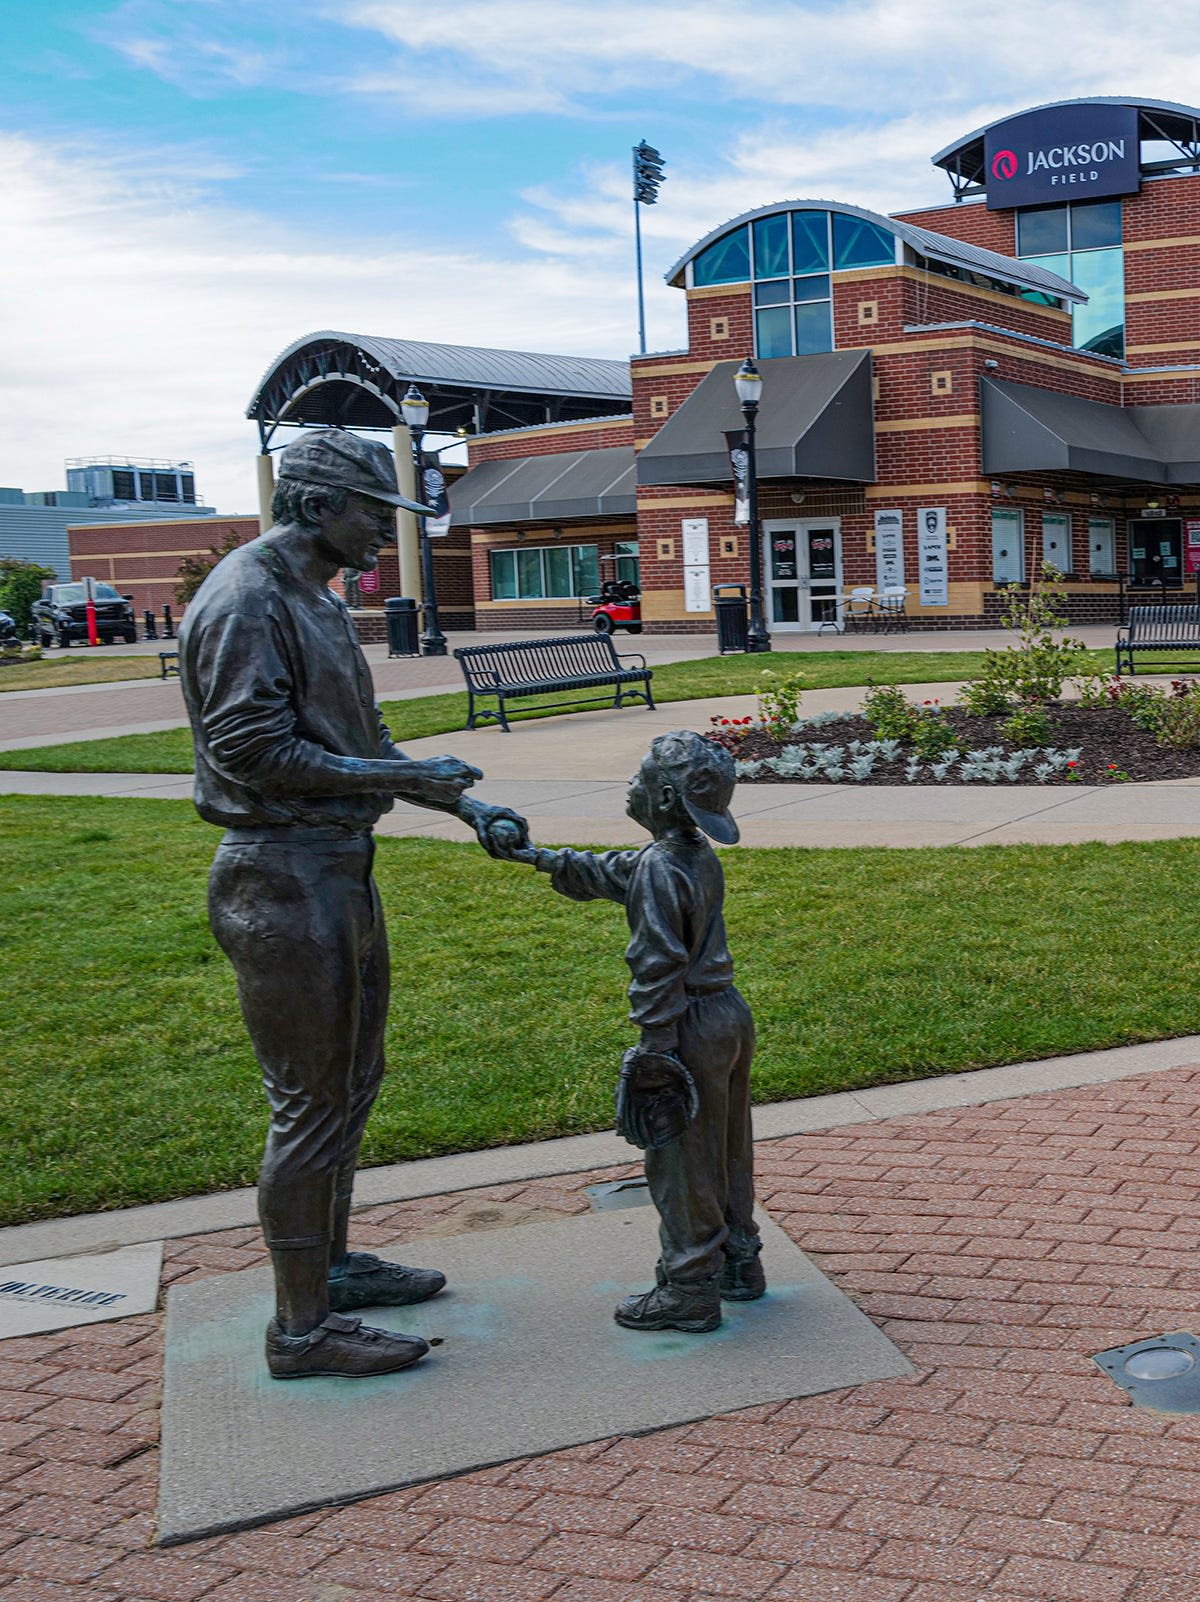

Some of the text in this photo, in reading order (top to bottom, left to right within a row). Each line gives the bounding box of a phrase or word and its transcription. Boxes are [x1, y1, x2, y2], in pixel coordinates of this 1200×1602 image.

[1026, 139, 1125, 175] JACKSON
[1051, 171, 1099, 186] FIELD
[0, 1280, 128, 1306] OLVERINE
